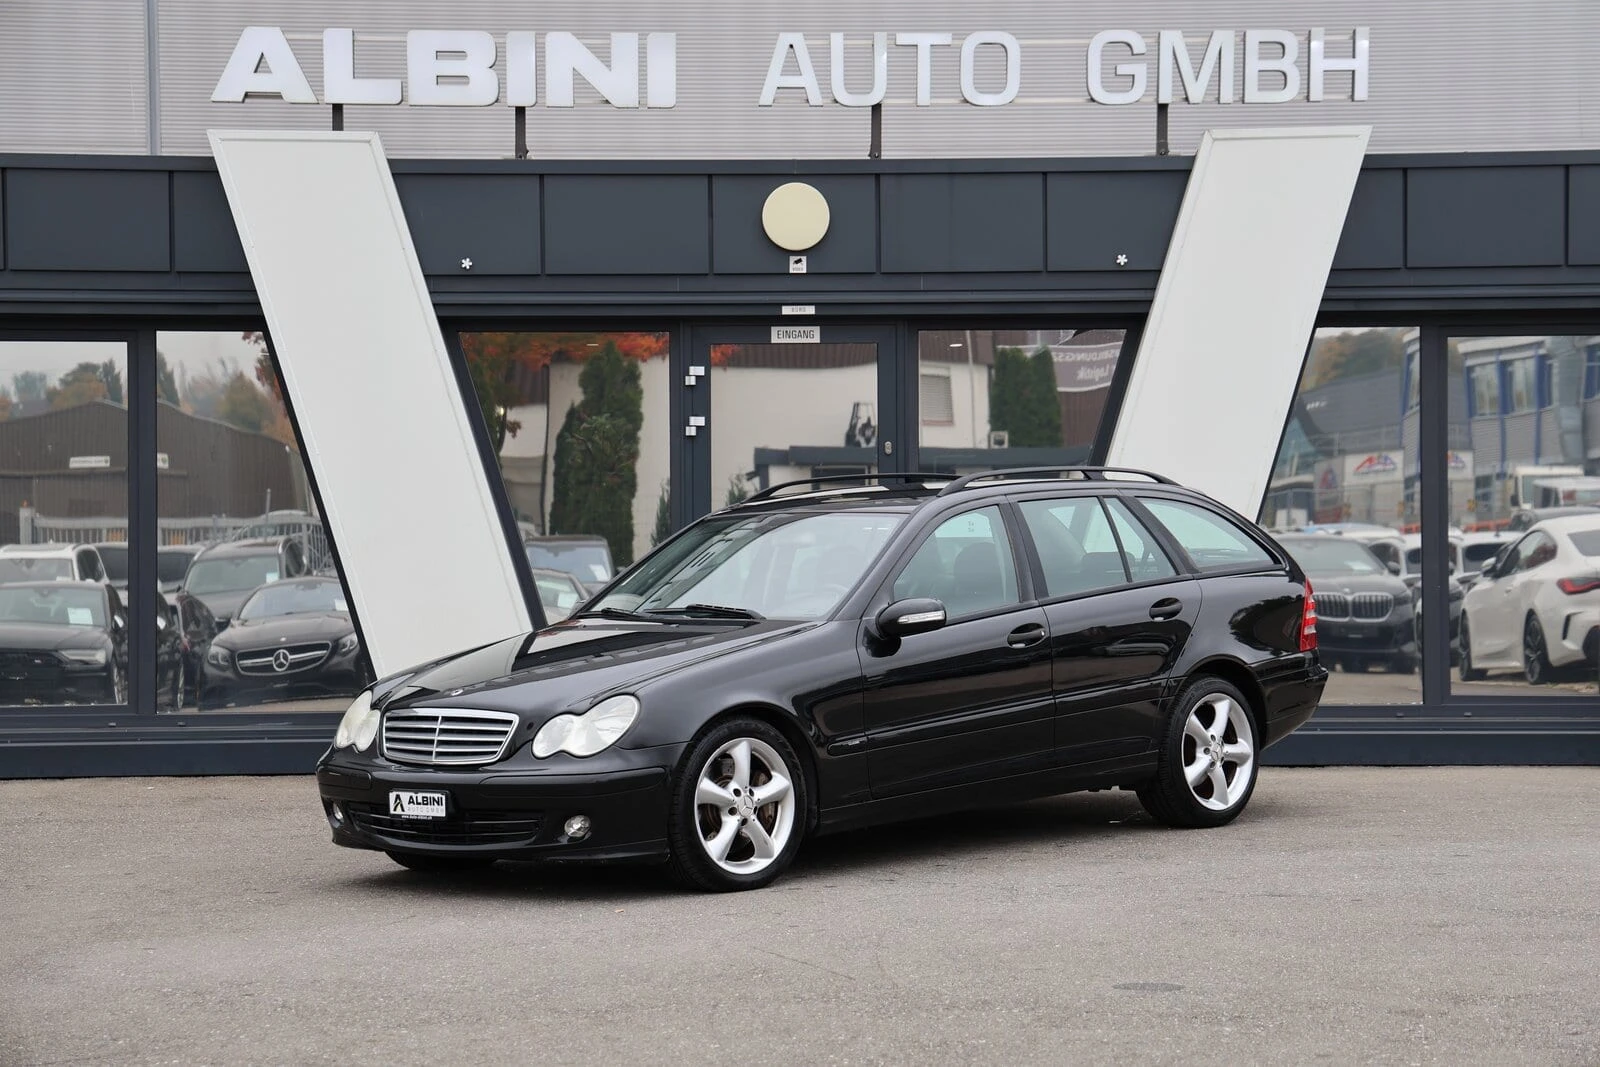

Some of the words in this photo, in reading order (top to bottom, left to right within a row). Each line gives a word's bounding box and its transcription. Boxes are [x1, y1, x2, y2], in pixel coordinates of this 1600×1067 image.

[210, 26, 677, 109] ALBINI
[758, 30, 1021, 107] AUTO
[1086, 26, 1371, 105] GMBH
[776, 329, 815, 340] EINGANG
[408, 795, 443, 806] ALBINI
